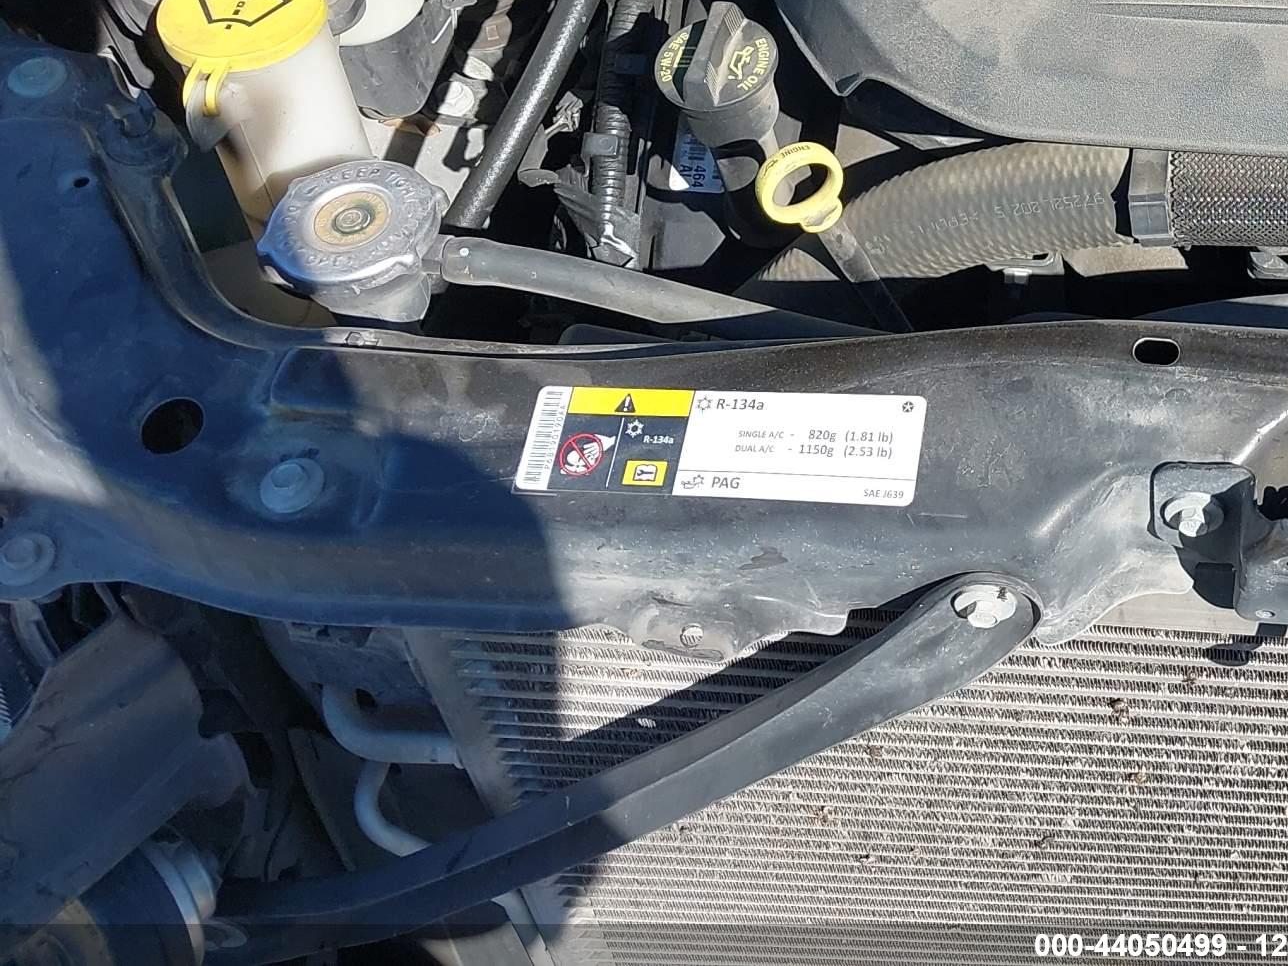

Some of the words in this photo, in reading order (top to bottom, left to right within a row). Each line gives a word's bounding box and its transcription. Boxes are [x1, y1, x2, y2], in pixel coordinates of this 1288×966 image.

[668, 32, 689, 50] SAE
[752, 37, 770, 75] ENGINE
[660, 51, 674, 82] 5W-20
[736, 75, 758, 91] OIL
[692, 165, 707, 188] 464
[716, 398, 765, 411] R-134a
[643, 435, 674, 444] R-134a
[738, 430, 767, 439] SINGLE
[768, 431, 785, 439] A/C
[808, 429, 837, 443] 820g
[845, 431, 875, 443] (1.81
[877, 432, 894, 444] lb)
[734, 444, 757, 453] DUAL
[758, 445, 776, 453] A/C
[798, 444, 835, 458] 1150g
[843, 445, 874, 458] (2.53
[876, 446, 893, 459] lb)
[711, 476, 741, 490] PAG
[864, 489, 881, 498] SAE
